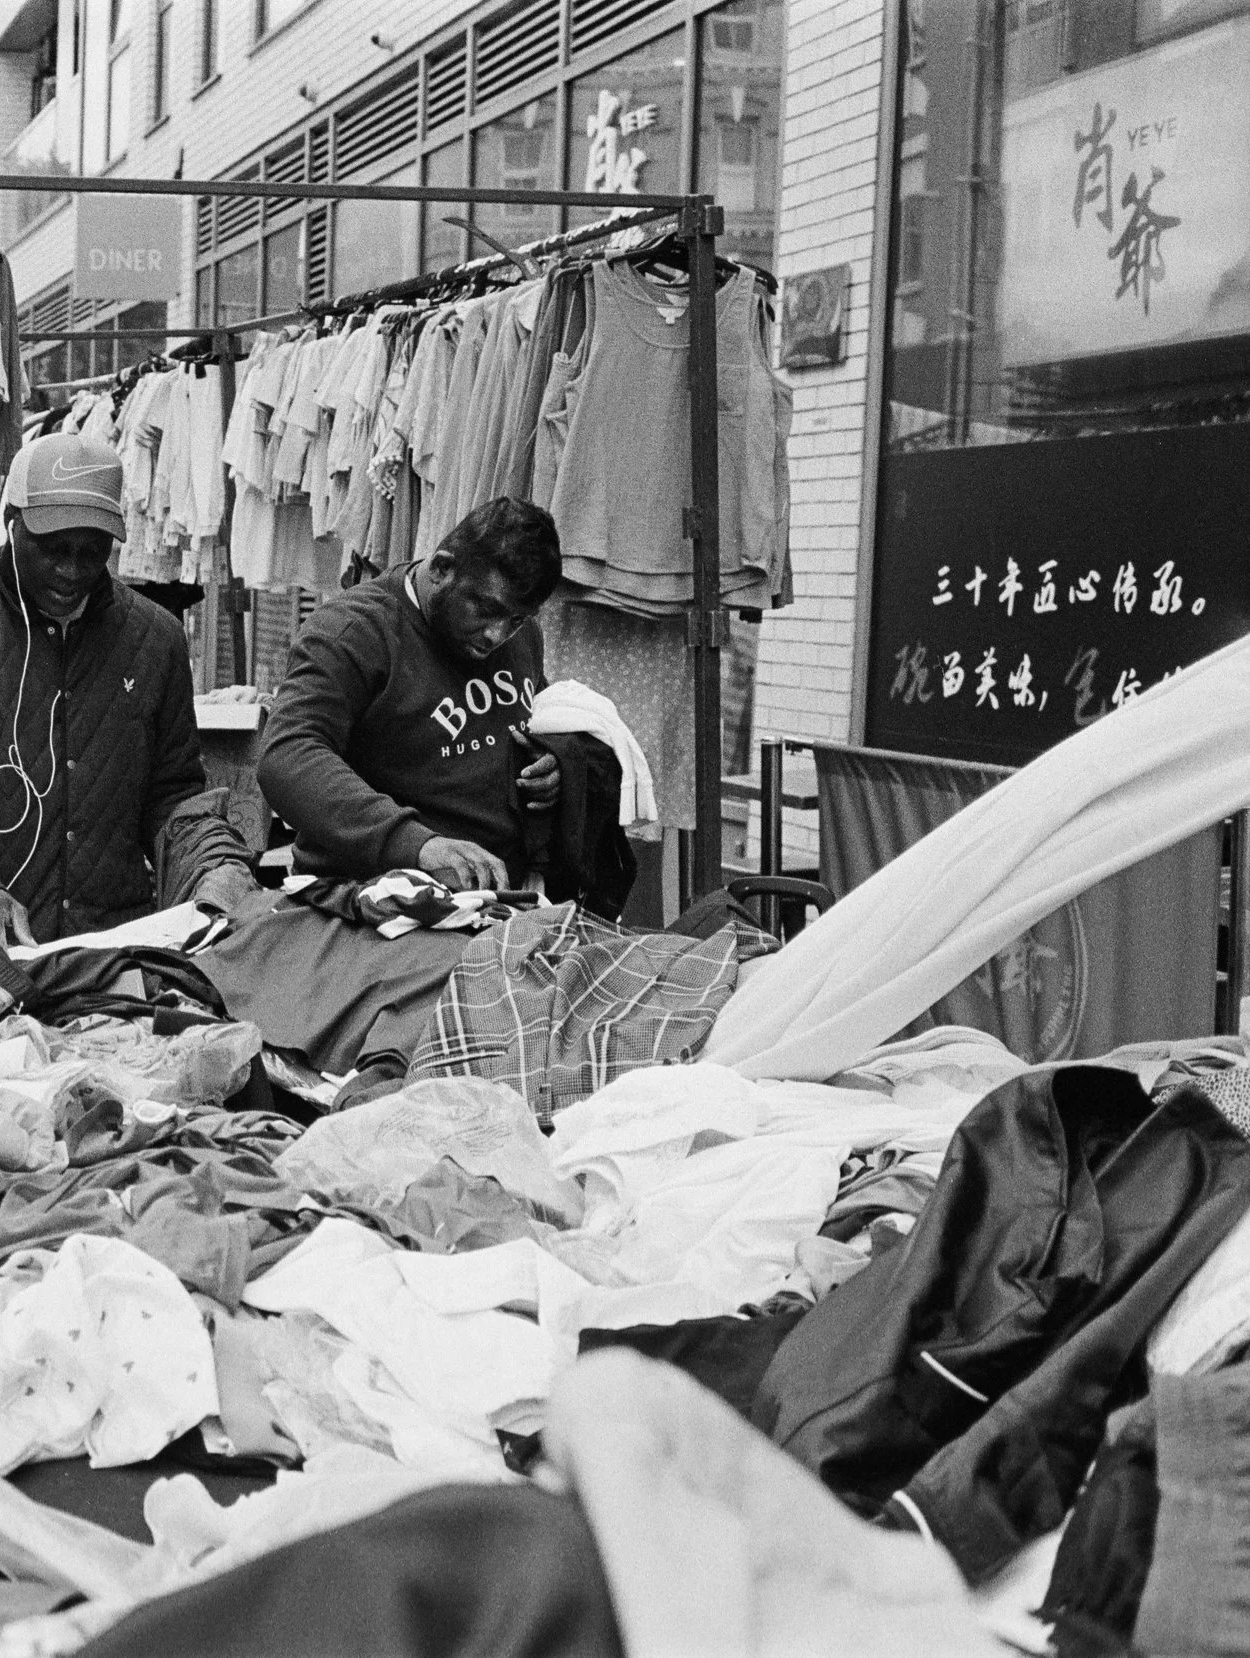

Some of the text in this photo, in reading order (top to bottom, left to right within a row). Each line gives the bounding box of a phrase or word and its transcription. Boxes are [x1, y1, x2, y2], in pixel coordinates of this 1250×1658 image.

[1127, 117, 1178, 151] YEYE
[89, 248, 162, 272] DINER
[441, 735, 496, 757] HUGO
